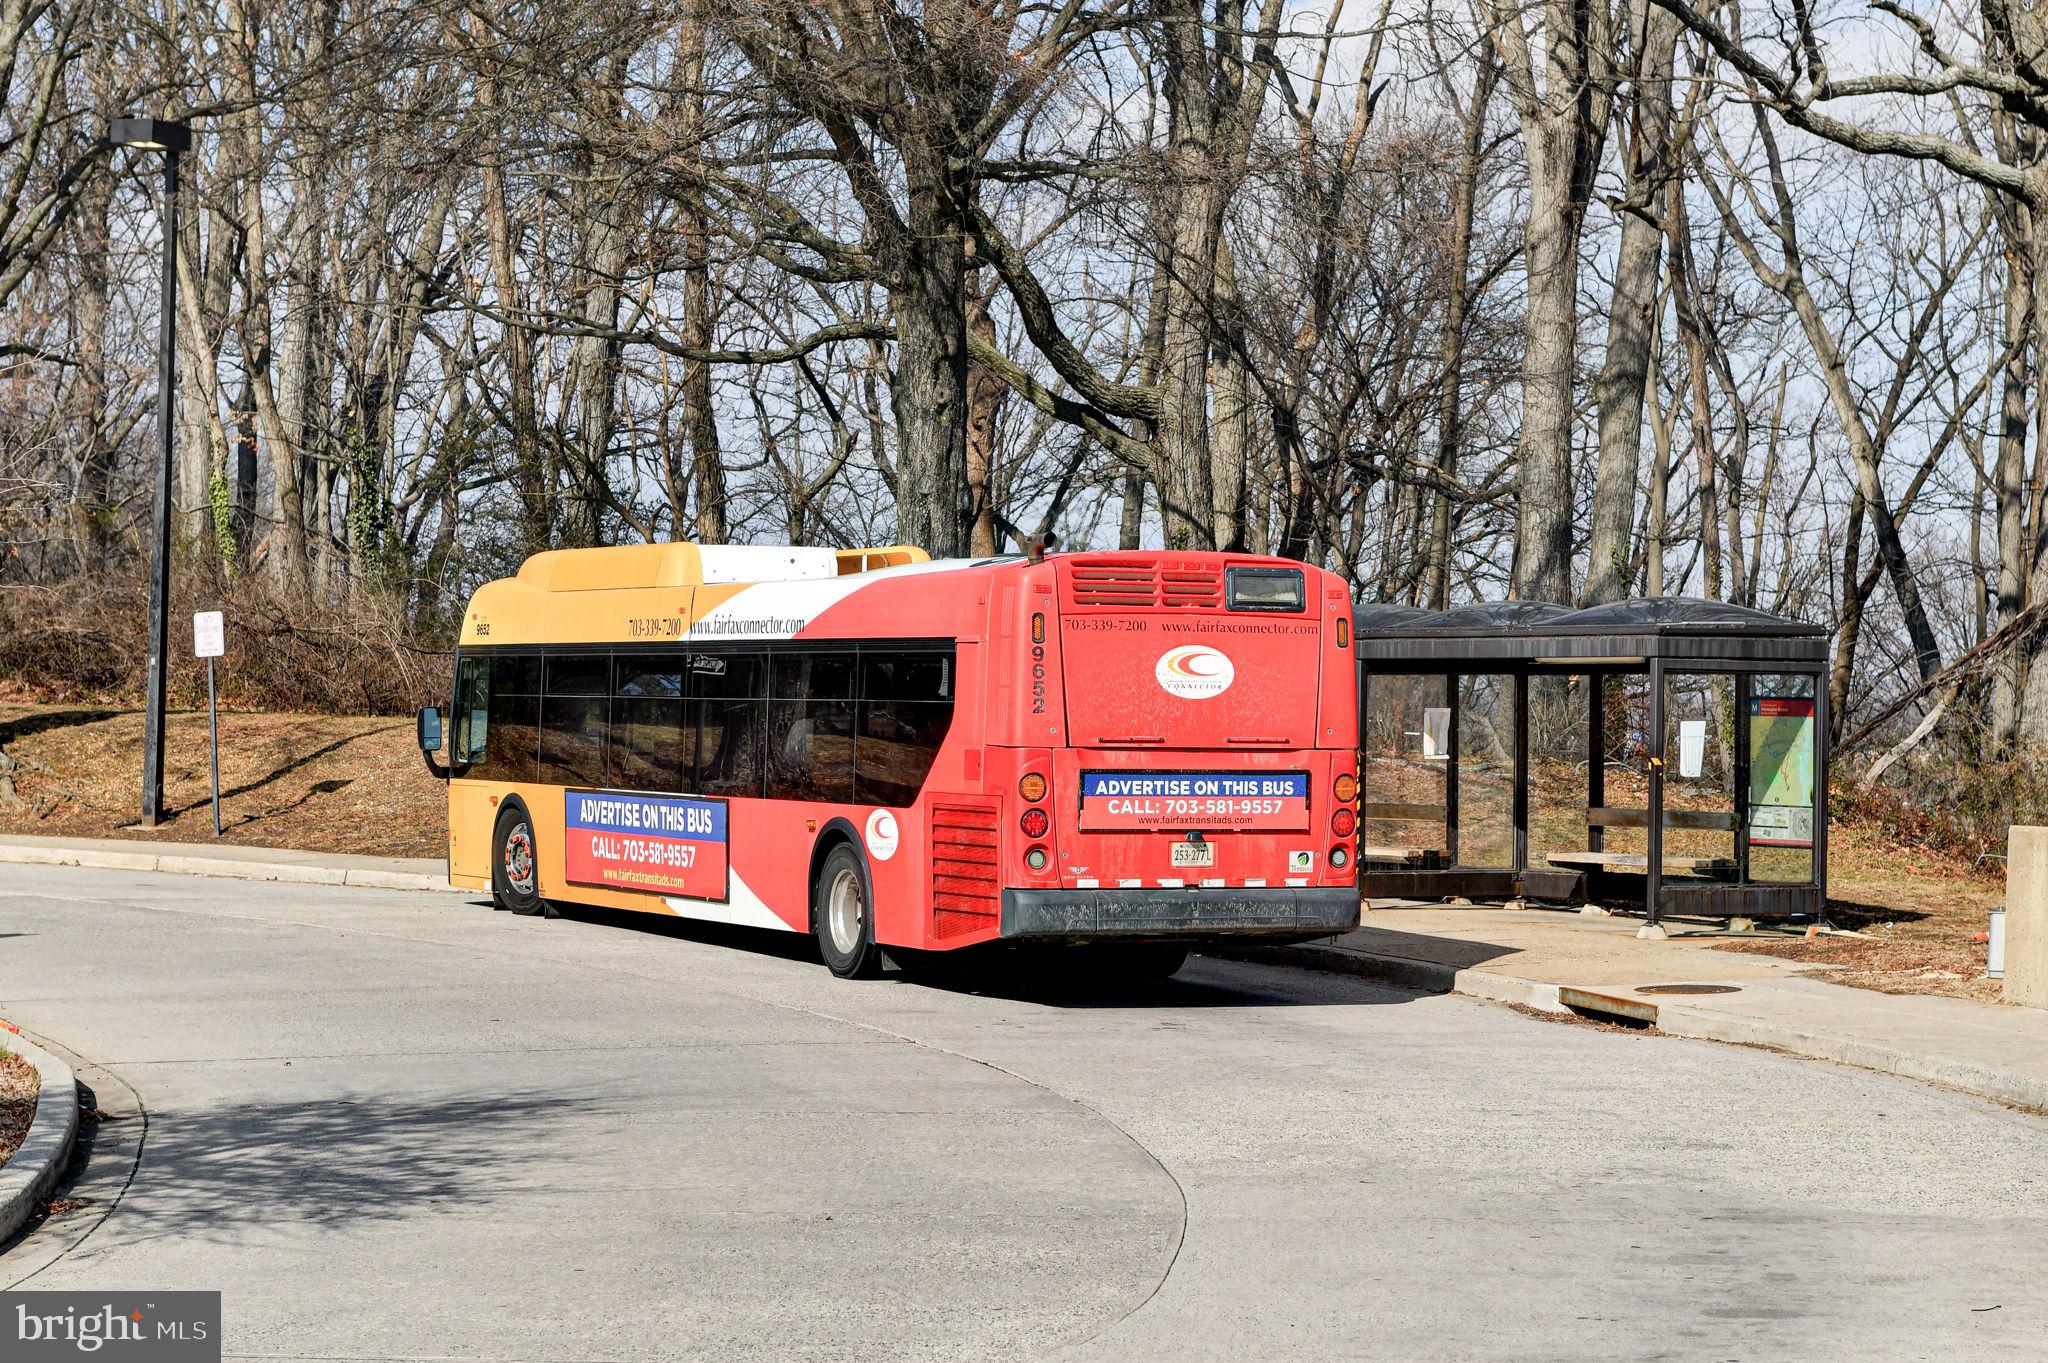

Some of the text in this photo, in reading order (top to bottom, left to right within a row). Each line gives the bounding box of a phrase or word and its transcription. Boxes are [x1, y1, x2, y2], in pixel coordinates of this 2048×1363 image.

[476, 624, 490, 636] 9652
[628, 614, 805, 637] 703-339-7200 www.fairfaxconnector.com
[1064, 619, 1319, 635] 703-339-7200 www.fairfaxconnector.com
[1031, 646, 1045, 714] 9652
[1095, 780, 1294, 795] ADVERTISE ON THIS BUS
[1108, 800, 1283, 814] CALL: 703-581-9557
[580, 799, 713, 834] ADVERTISE ON THIS BUS
[1138, 815, 1253, 825] www.fairfaxtransitads.com
[591, 836, 696, 868] CALL: 703-581-9557
[603, 868, 685, 889] www.fairfaxtransitads.com
